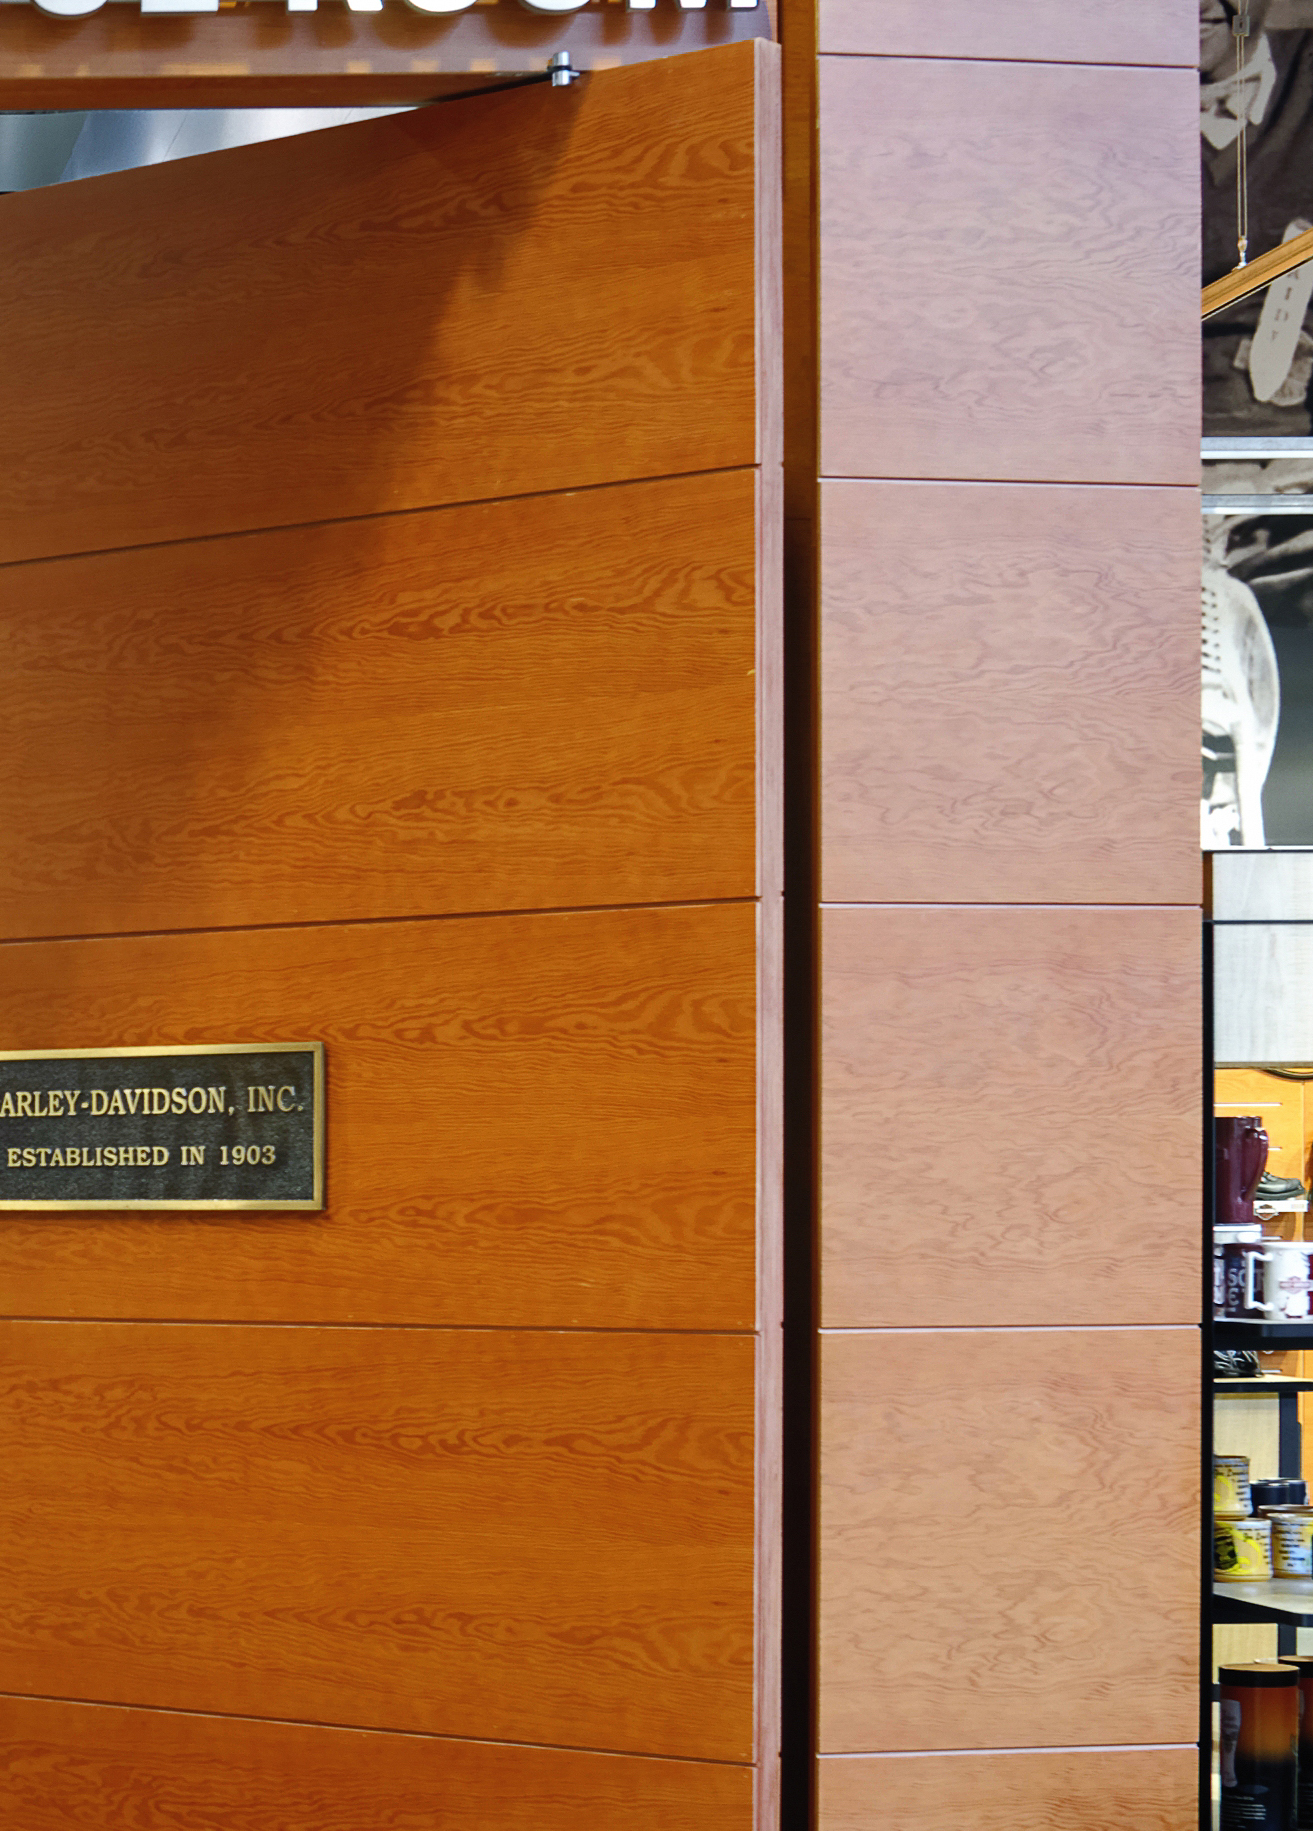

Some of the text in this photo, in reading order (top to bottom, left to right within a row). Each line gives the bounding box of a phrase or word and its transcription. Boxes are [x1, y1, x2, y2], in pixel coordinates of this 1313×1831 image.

[247, 1085, 304, 1113] INC.
[7, 1145, 276, 1167] ESTABLISHED IN 1903
